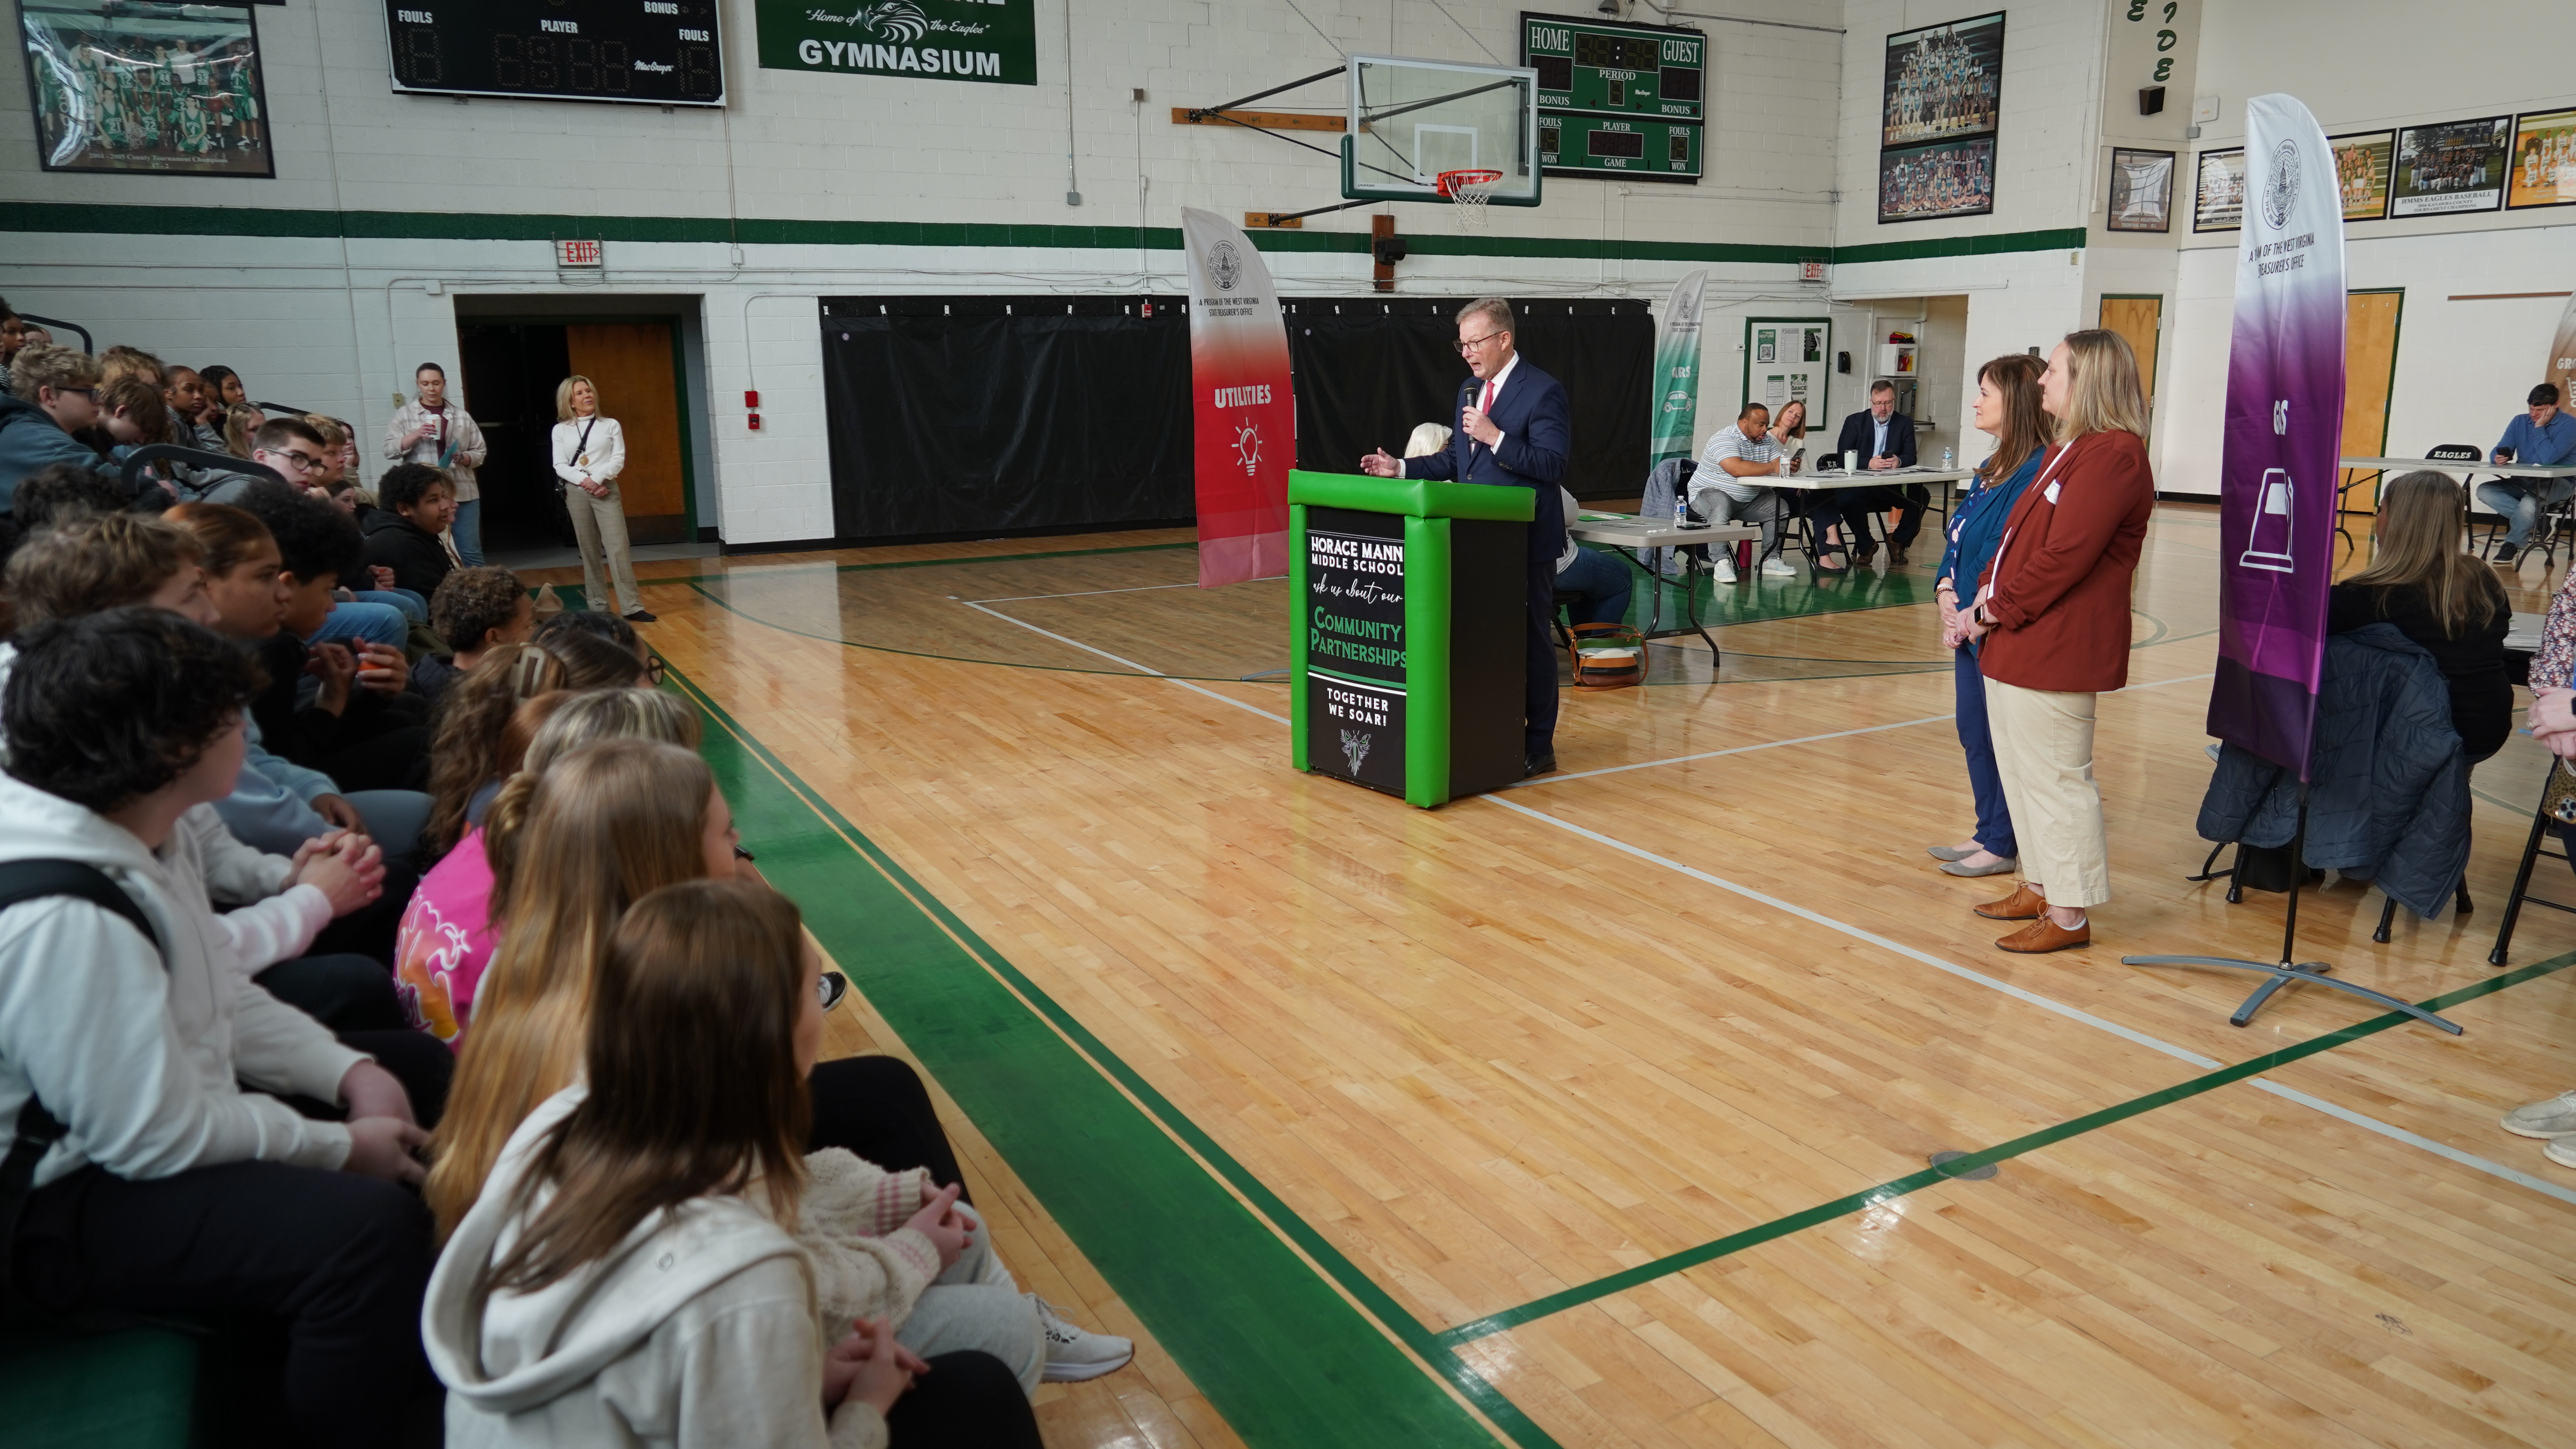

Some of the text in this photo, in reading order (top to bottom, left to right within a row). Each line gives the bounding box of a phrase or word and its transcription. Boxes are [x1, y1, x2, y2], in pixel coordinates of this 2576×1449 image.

[644, 2, 678, 15] BONUS
[398, 10, 433, 24] FOULS
[846, 12, 862, 26] of
[930, 20, 948, 31] the
[541, 19, 578, 33] PLAYER
[678, 29, 708, 41] FOULS
[1531, 27, 1569, 51] HOME
[799, 39, 1000, 77] GYMNASIUM
[1663, 39, 1699, 63] GUEST
[634, 60, 672, 75] MacGregor
[1599, 69, 1636, 80] PERIOD
[1539, 95, 1570, 105] BONUS
[1662, 104, 1690, 115] BONUS
[1539, 117, 1561, 127] FOULS
[1603, 121, 1630, 131] PLAYER
[1669, 126, 1690, 136] FOULS
[1913, 130, 1946, 139] Conference
[1947, 125, 1981, 133] Champions
[1542, 154, 1557, 164] WON
[1604, 158, 1626, 167] GAME
[1671, 162, 1686, 170] WON
[2454, 191, 2492, 200] BASEBALL
[565, 242, 593, 262] EXIT
[2248, 250, 2253, 262] A
[2263, 244, 2272, 257] OF
[2273, 241, 2283, 255] THE
[2296, 232, 2314, 250] VIRGINIA
[2291, 254, 2305, 270] OFFICE
[1806, 264, 1820, 278] EXIT
[1218, 308, 1239, 316] TREASURER'S
[1215, 384, 1271, 408] UTILITIES
[1311, 536, 1403, 562] HORACE MANN
[1312, 553, 1403, 576] MIDDLE SCHOOL
[1313, 573, 1403, 604] ask us about our
[1327, 688, 1388, 712] TOGETHER
[1328, 703, 1386, 727] WE SOAR!
